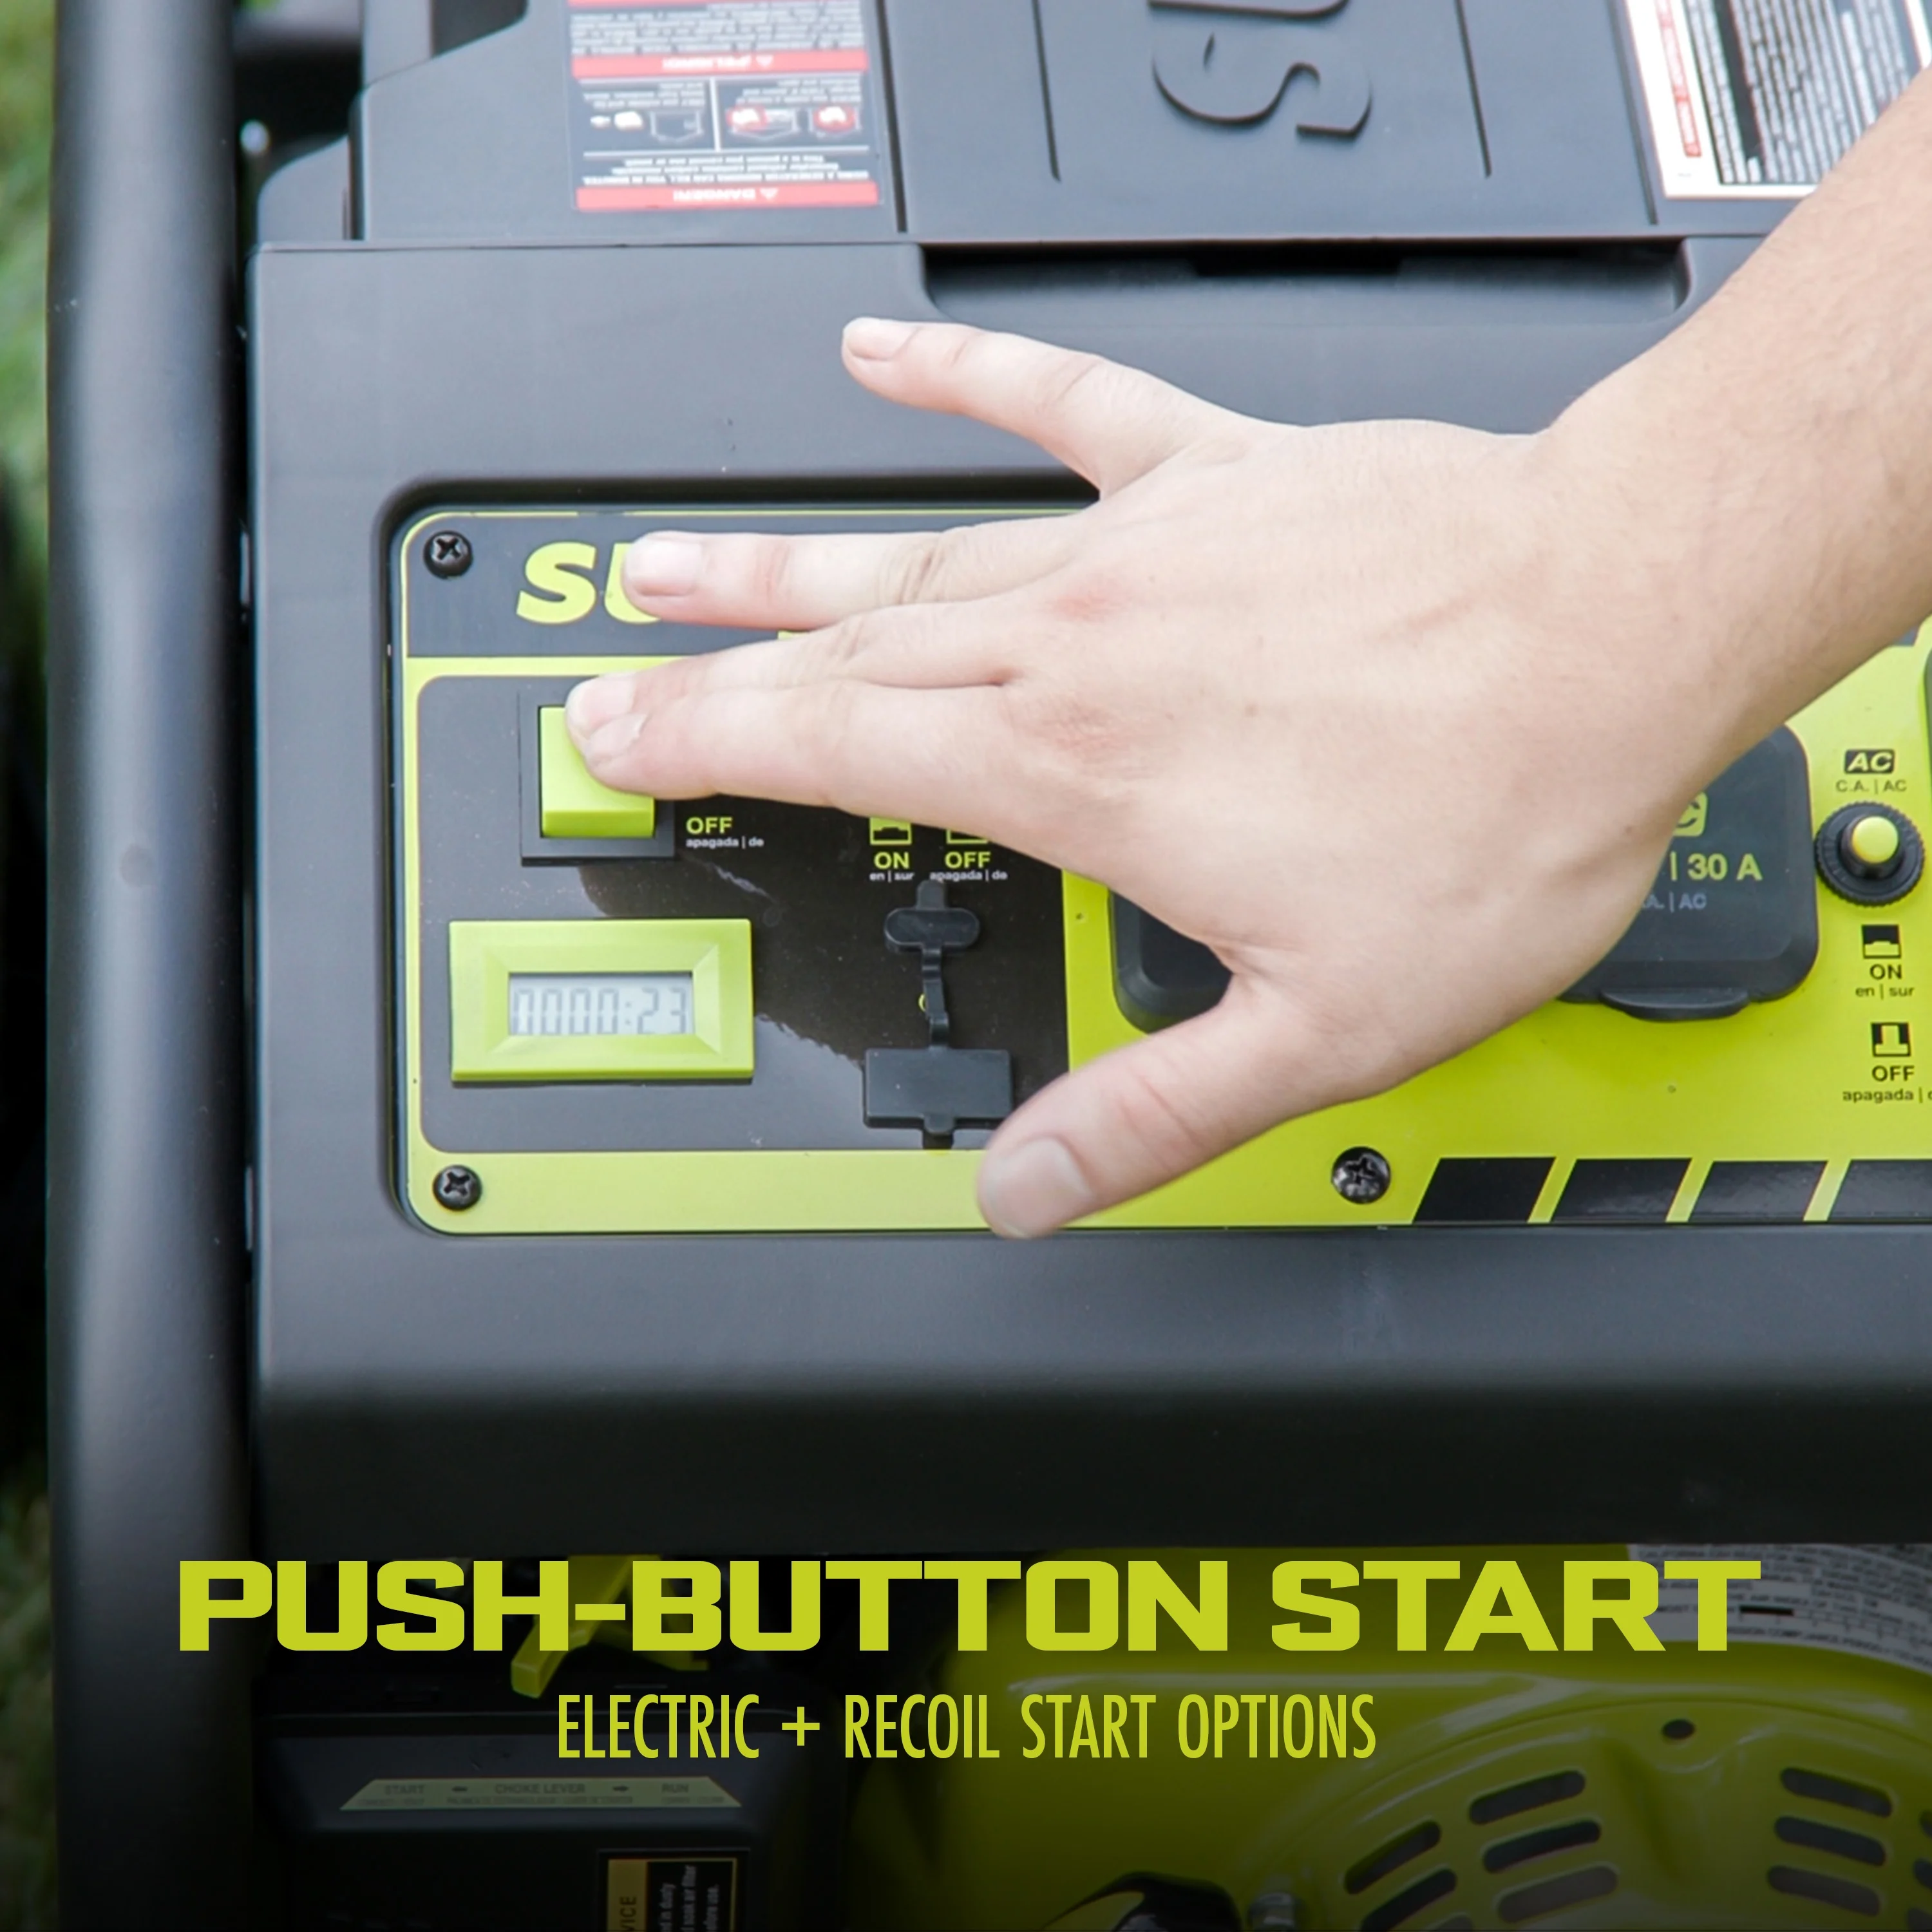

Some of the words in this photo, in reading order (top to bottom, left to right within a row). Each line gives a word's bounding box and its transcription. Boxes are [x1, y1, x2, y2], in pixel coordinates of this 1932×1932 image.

[1847, 751, 1893, 772] AC
[1835, 779, 1870, 793] C.A.
[1883, 779, 1908, 793] AC
[685, 816, 733, 835] OFF
[685, 837, 739, 849] apagada
[748, 837, 764, 847] de
[873, 851, 910, 869] ON
[944, 851, 991, 869] OFF
[1687, 852, 1728, 881] 30
[1736, 852, 1763, 881] A
[869, 871, 886, 881] en
[894, 871, 914, 881] sur
[929, 871, 983, 882] apagada
[991, 870, 1009, 880] de
[1678, 893, 1707, 911] AC
[1870, 964, 1902, 980] ON
[1855, 985, 1875, 997] en
[1889, 986, 1915, 997] sur
[512, 987, 687, 1036] 0000:23
[1871, 1065, 1915, 1083] OFF
[1842, 1088, 1914, 1104] apagada
[384, 1784, 425, 1795] START
[495, 1783, 540, 1794] CHOKE
[544, 1783, 586, 1794] LEVER
[661, 1783, 690, 1794] RUN
